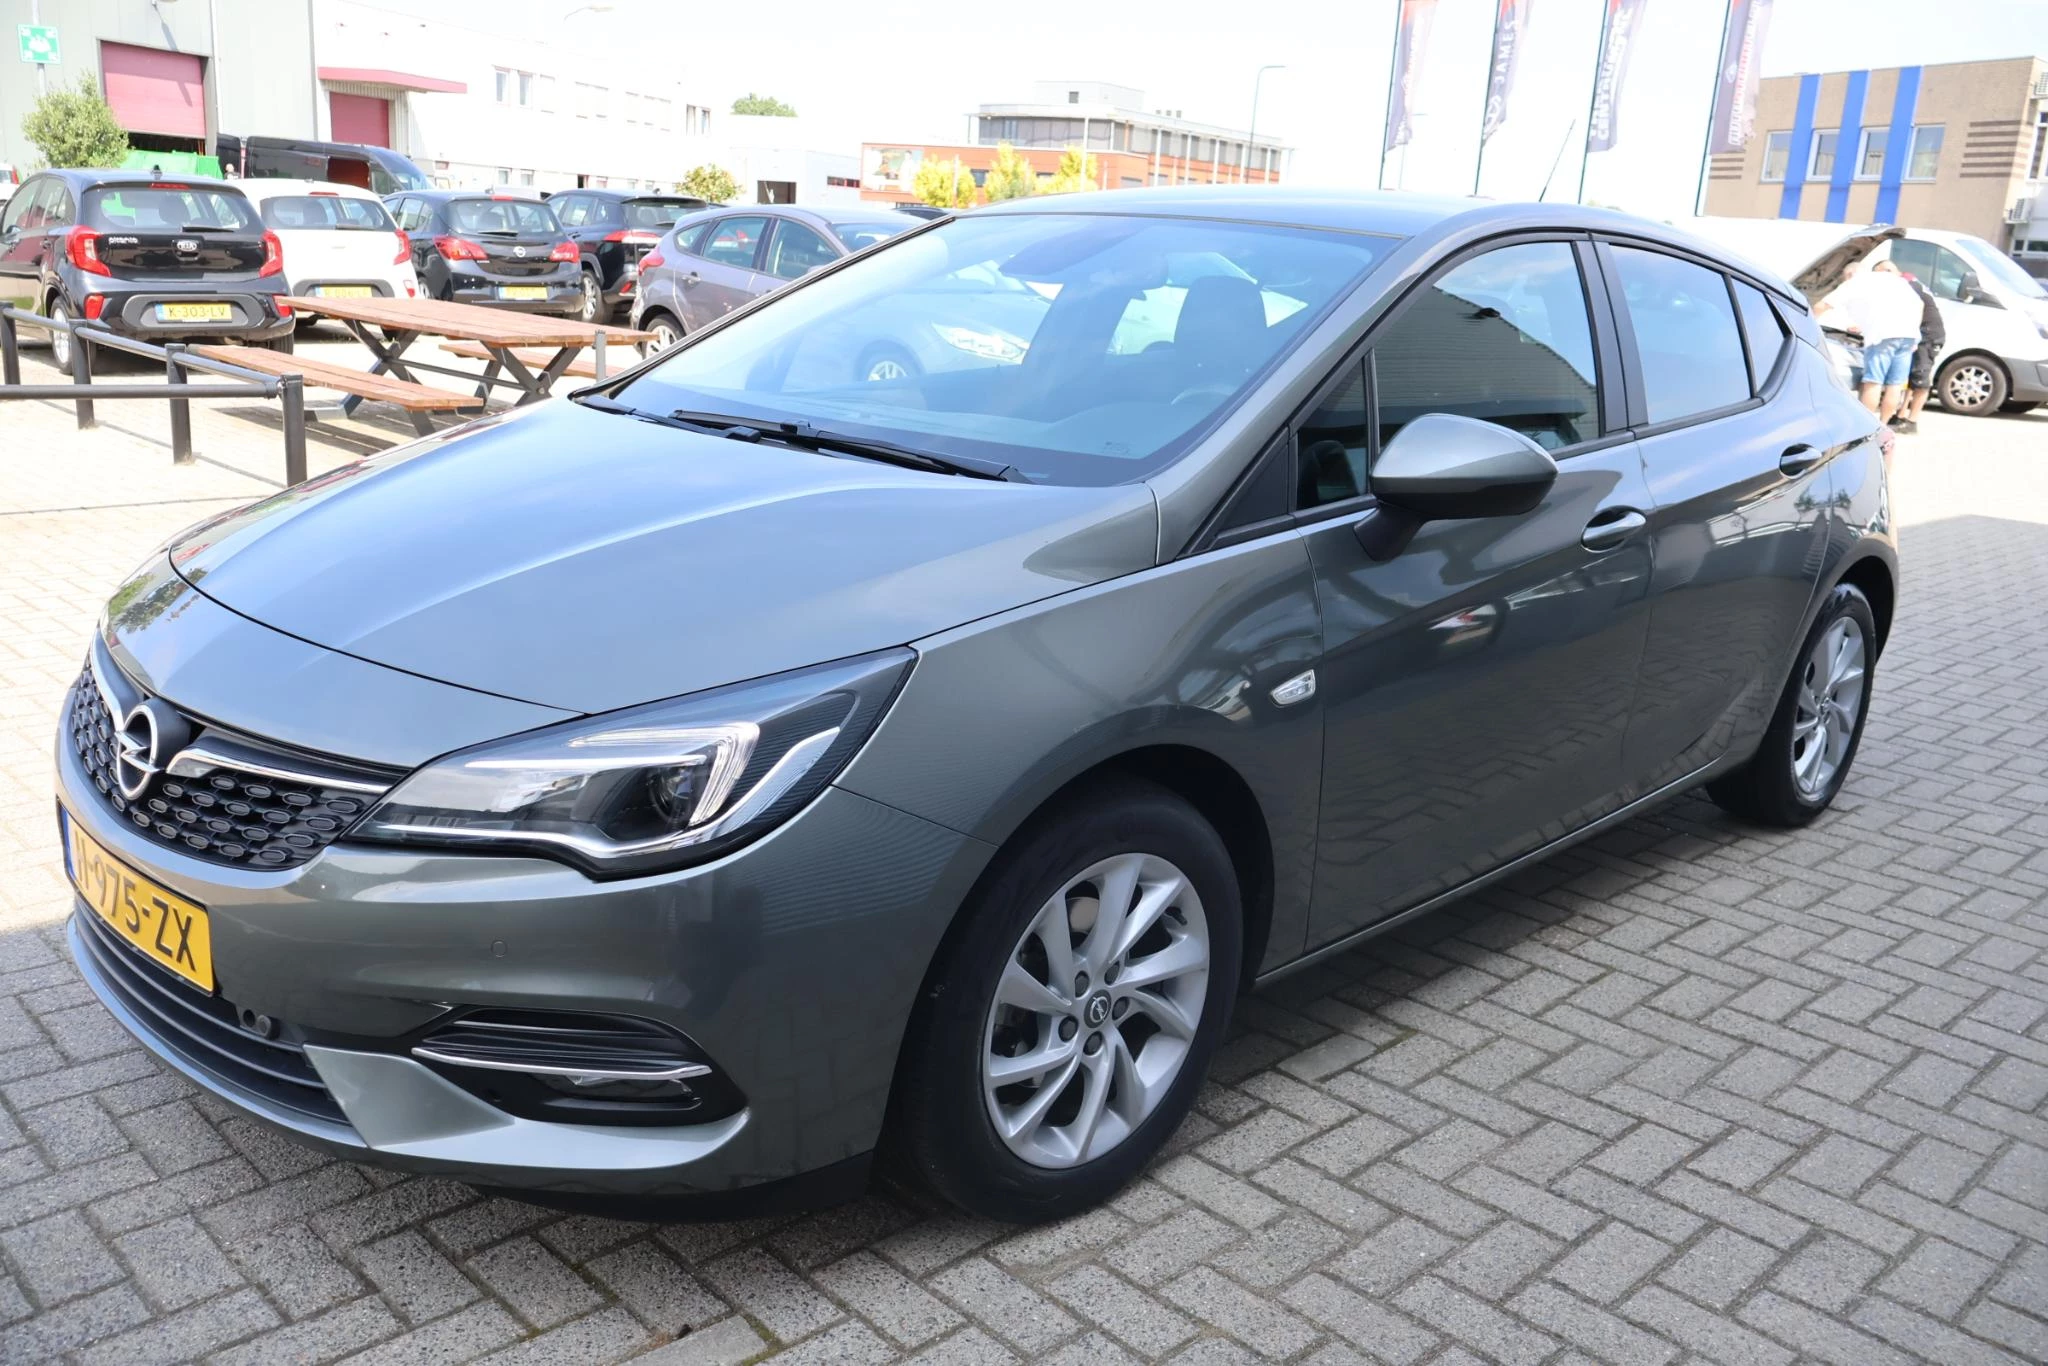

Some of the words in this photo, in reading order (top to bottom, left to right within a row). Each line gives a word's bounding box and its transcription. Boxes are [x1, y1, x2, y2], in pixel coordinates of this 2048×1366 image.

[1495, 20, 1518, 84] JAMES
[168, 306, 225, 318] K-303-LV
[75, 830, 196, 972] H-975-ZX
